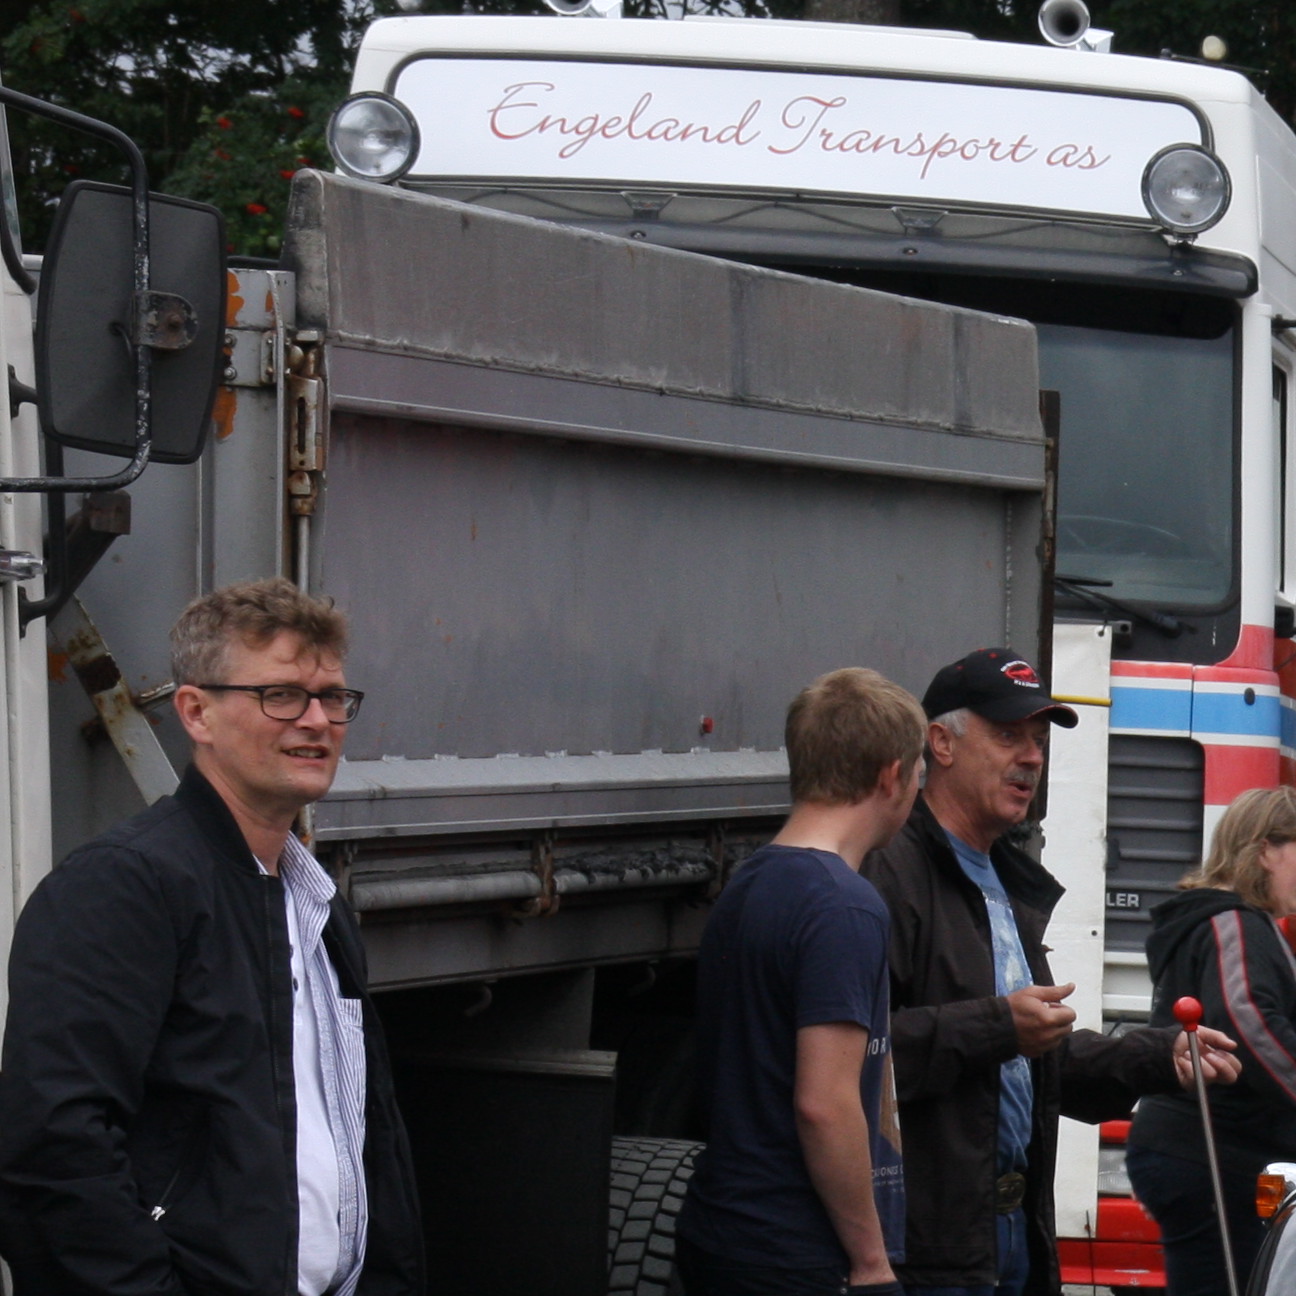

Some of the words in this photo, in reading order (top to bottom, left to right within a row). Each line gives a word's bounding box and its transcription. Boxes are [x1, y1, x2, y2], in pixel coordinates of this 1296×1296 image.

[487, 81, 761, 159] Engeland
[767, 95, 1038, 180] Transport
[1046, 143, 1111, 170] as
